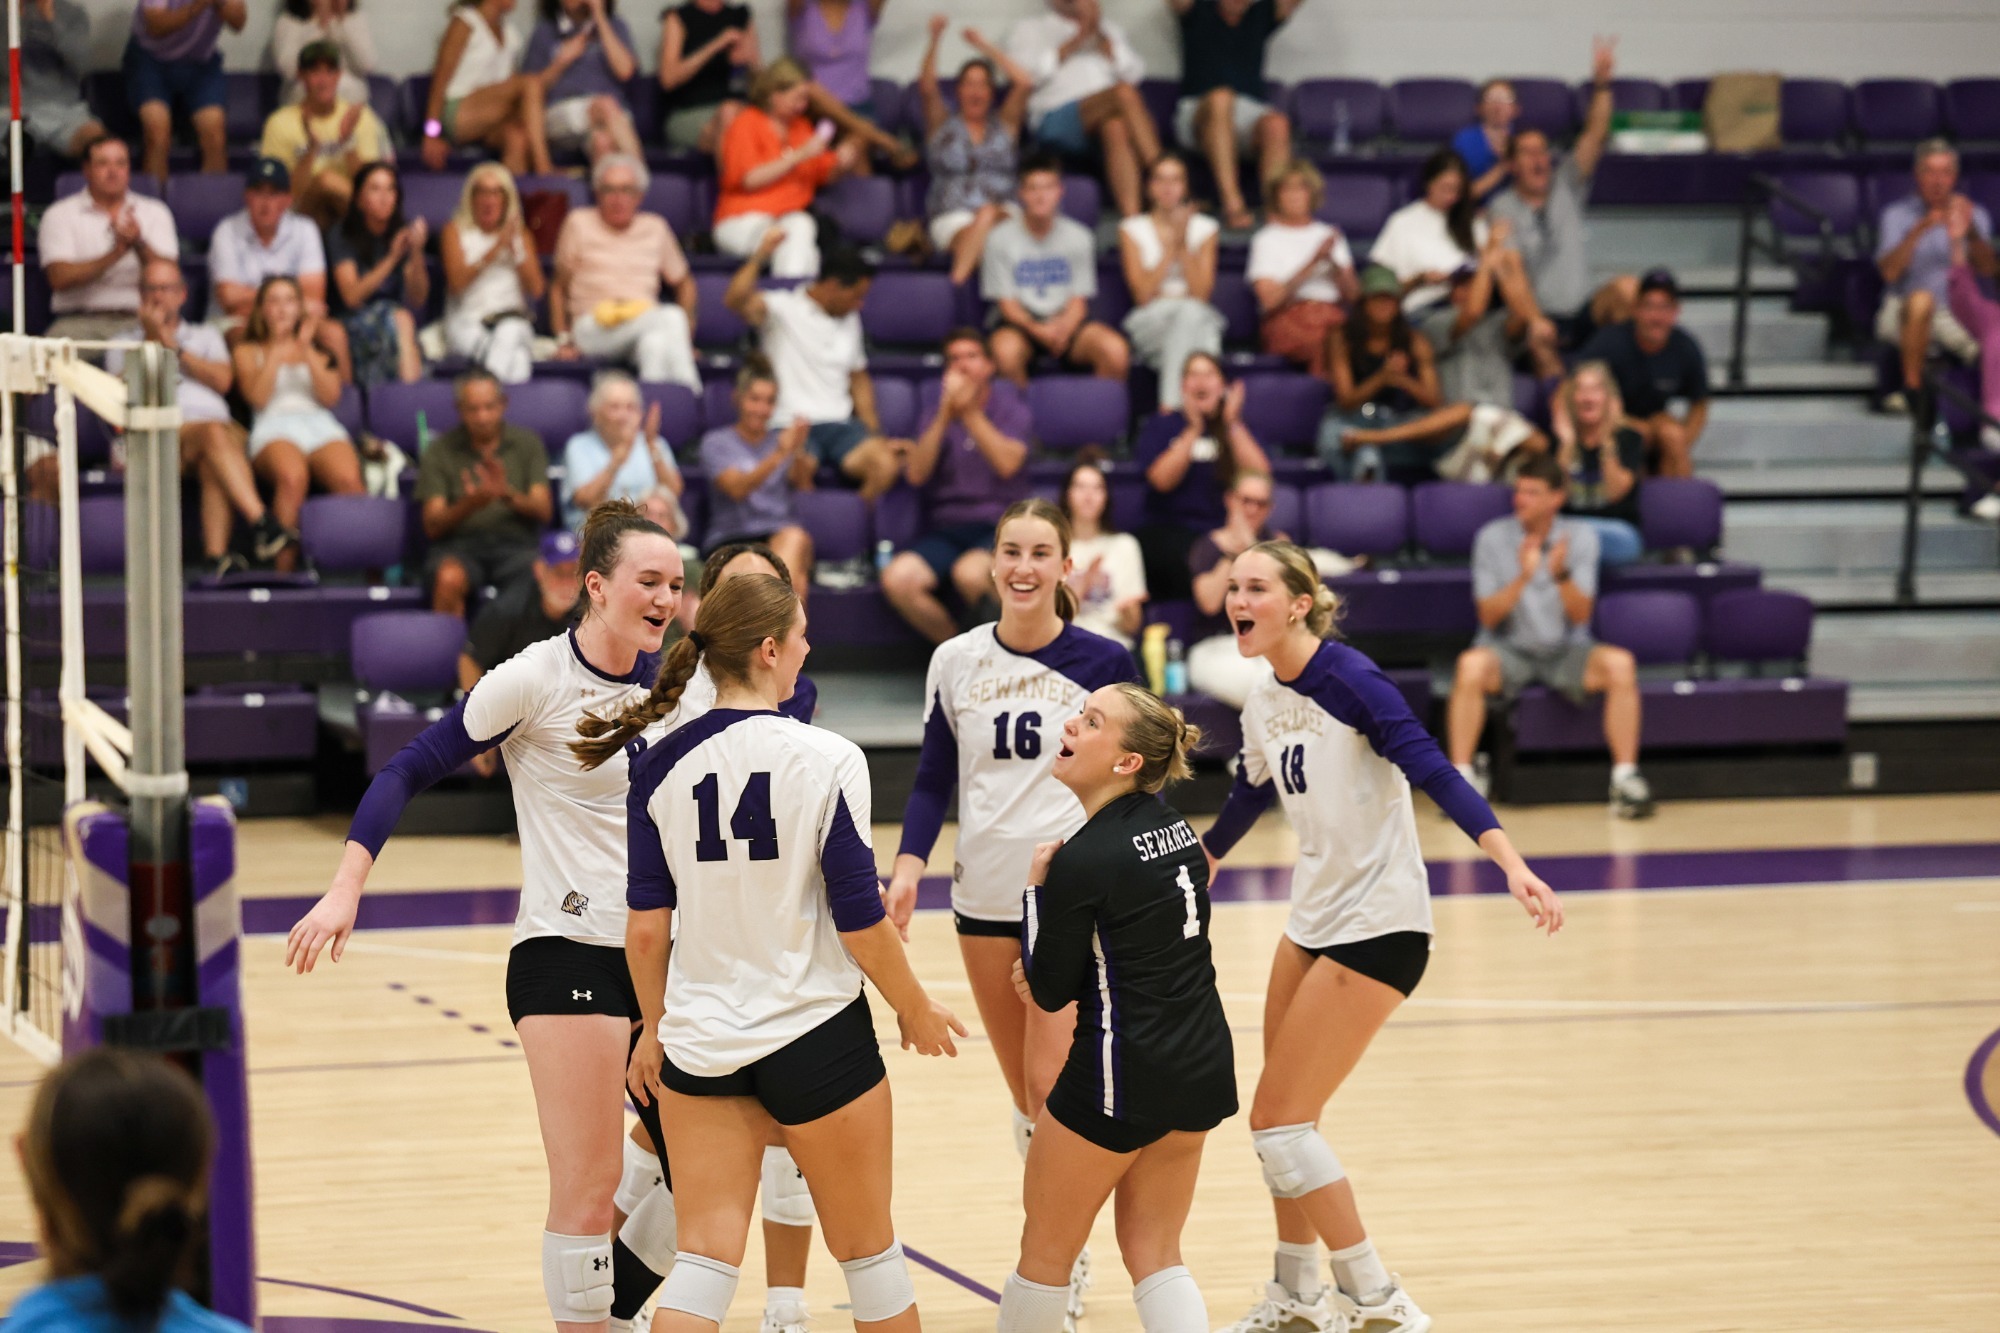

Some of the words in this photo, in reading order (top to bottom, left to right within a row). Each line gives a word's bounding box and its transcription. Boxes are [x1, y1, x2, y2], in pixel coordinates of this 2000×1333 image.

[968, 676, 1075, 708] SEWANEE
[992, 710, 1042, 760] 16
[1281, 744, 1307, 795] 18
[692, 771, 780, 862] 14
[1132, 819, 1198, 862] SEWANEE
[1175, 864, 1201, 940] 1
